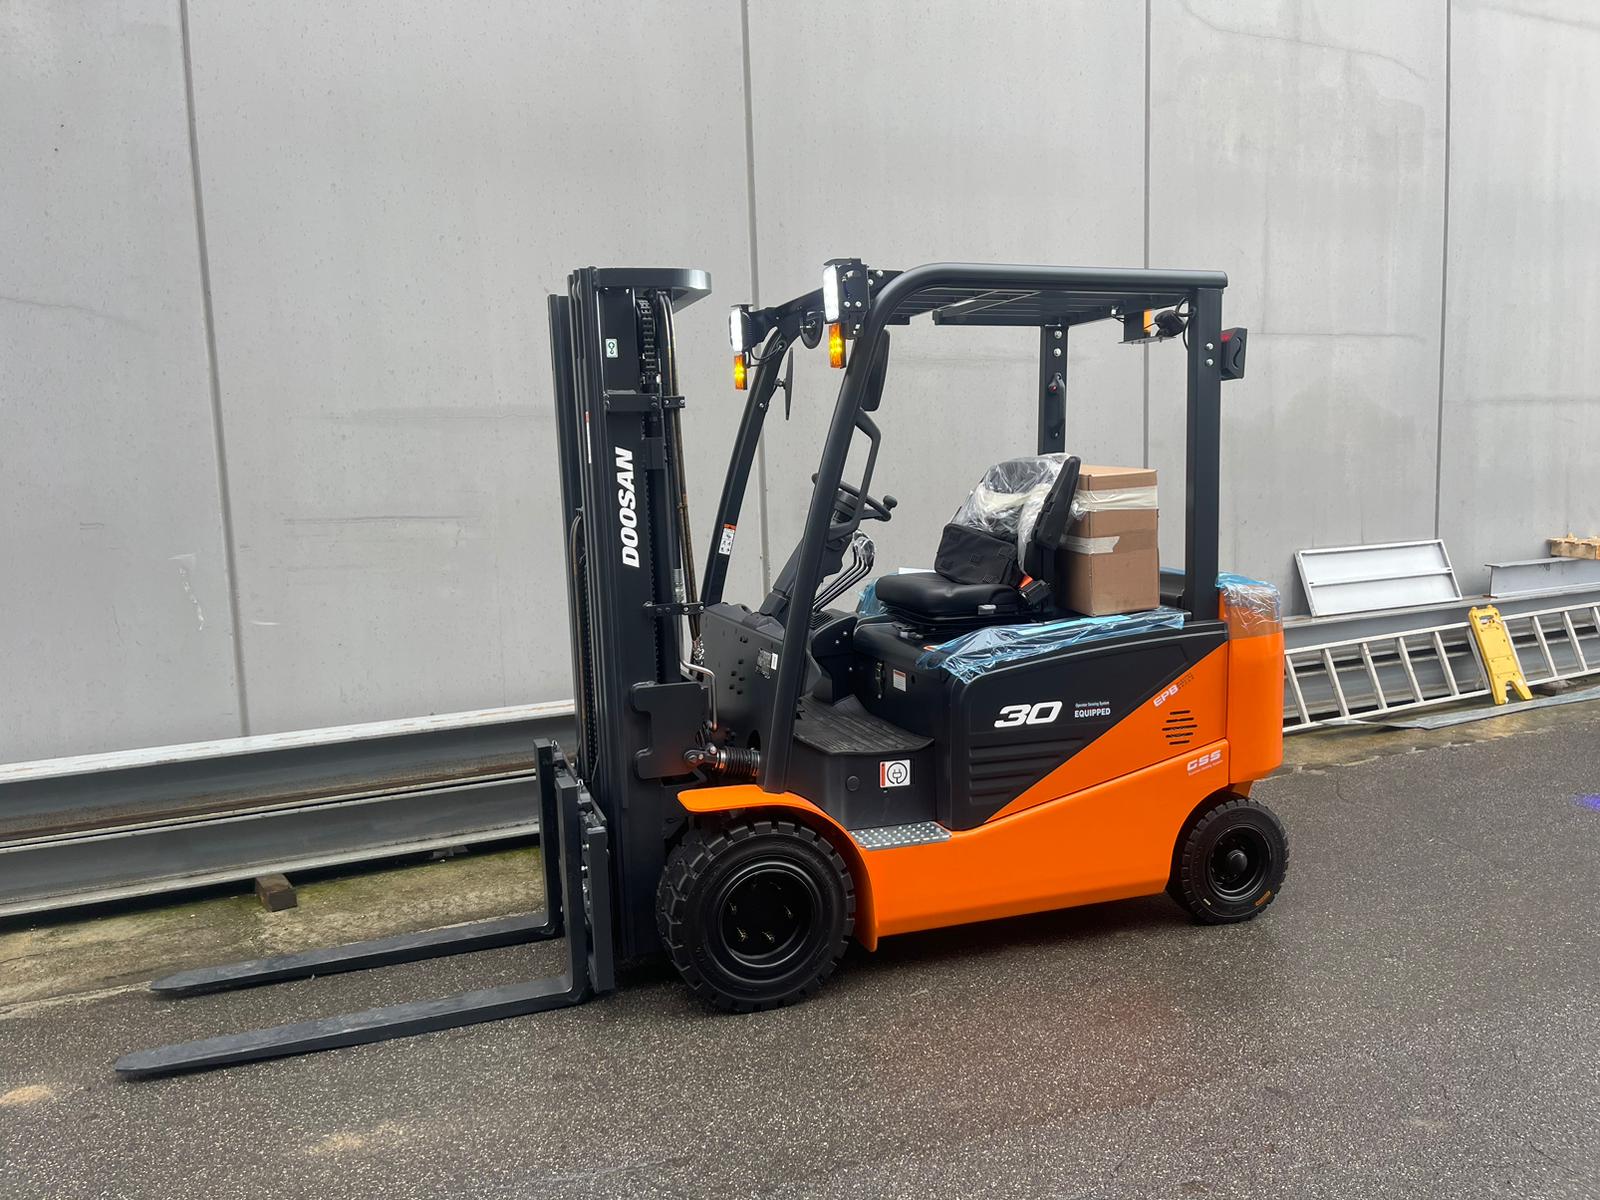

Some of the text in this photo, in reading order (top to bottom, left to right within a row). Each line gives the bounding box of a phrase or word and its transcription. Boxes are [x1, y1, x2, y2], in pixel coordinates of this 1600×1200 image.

[615, 446, 640, 568] DOOSAN
[994, 701, 1063, 728] 30
[1074, 707, 1111, 718] EQUIPPED
